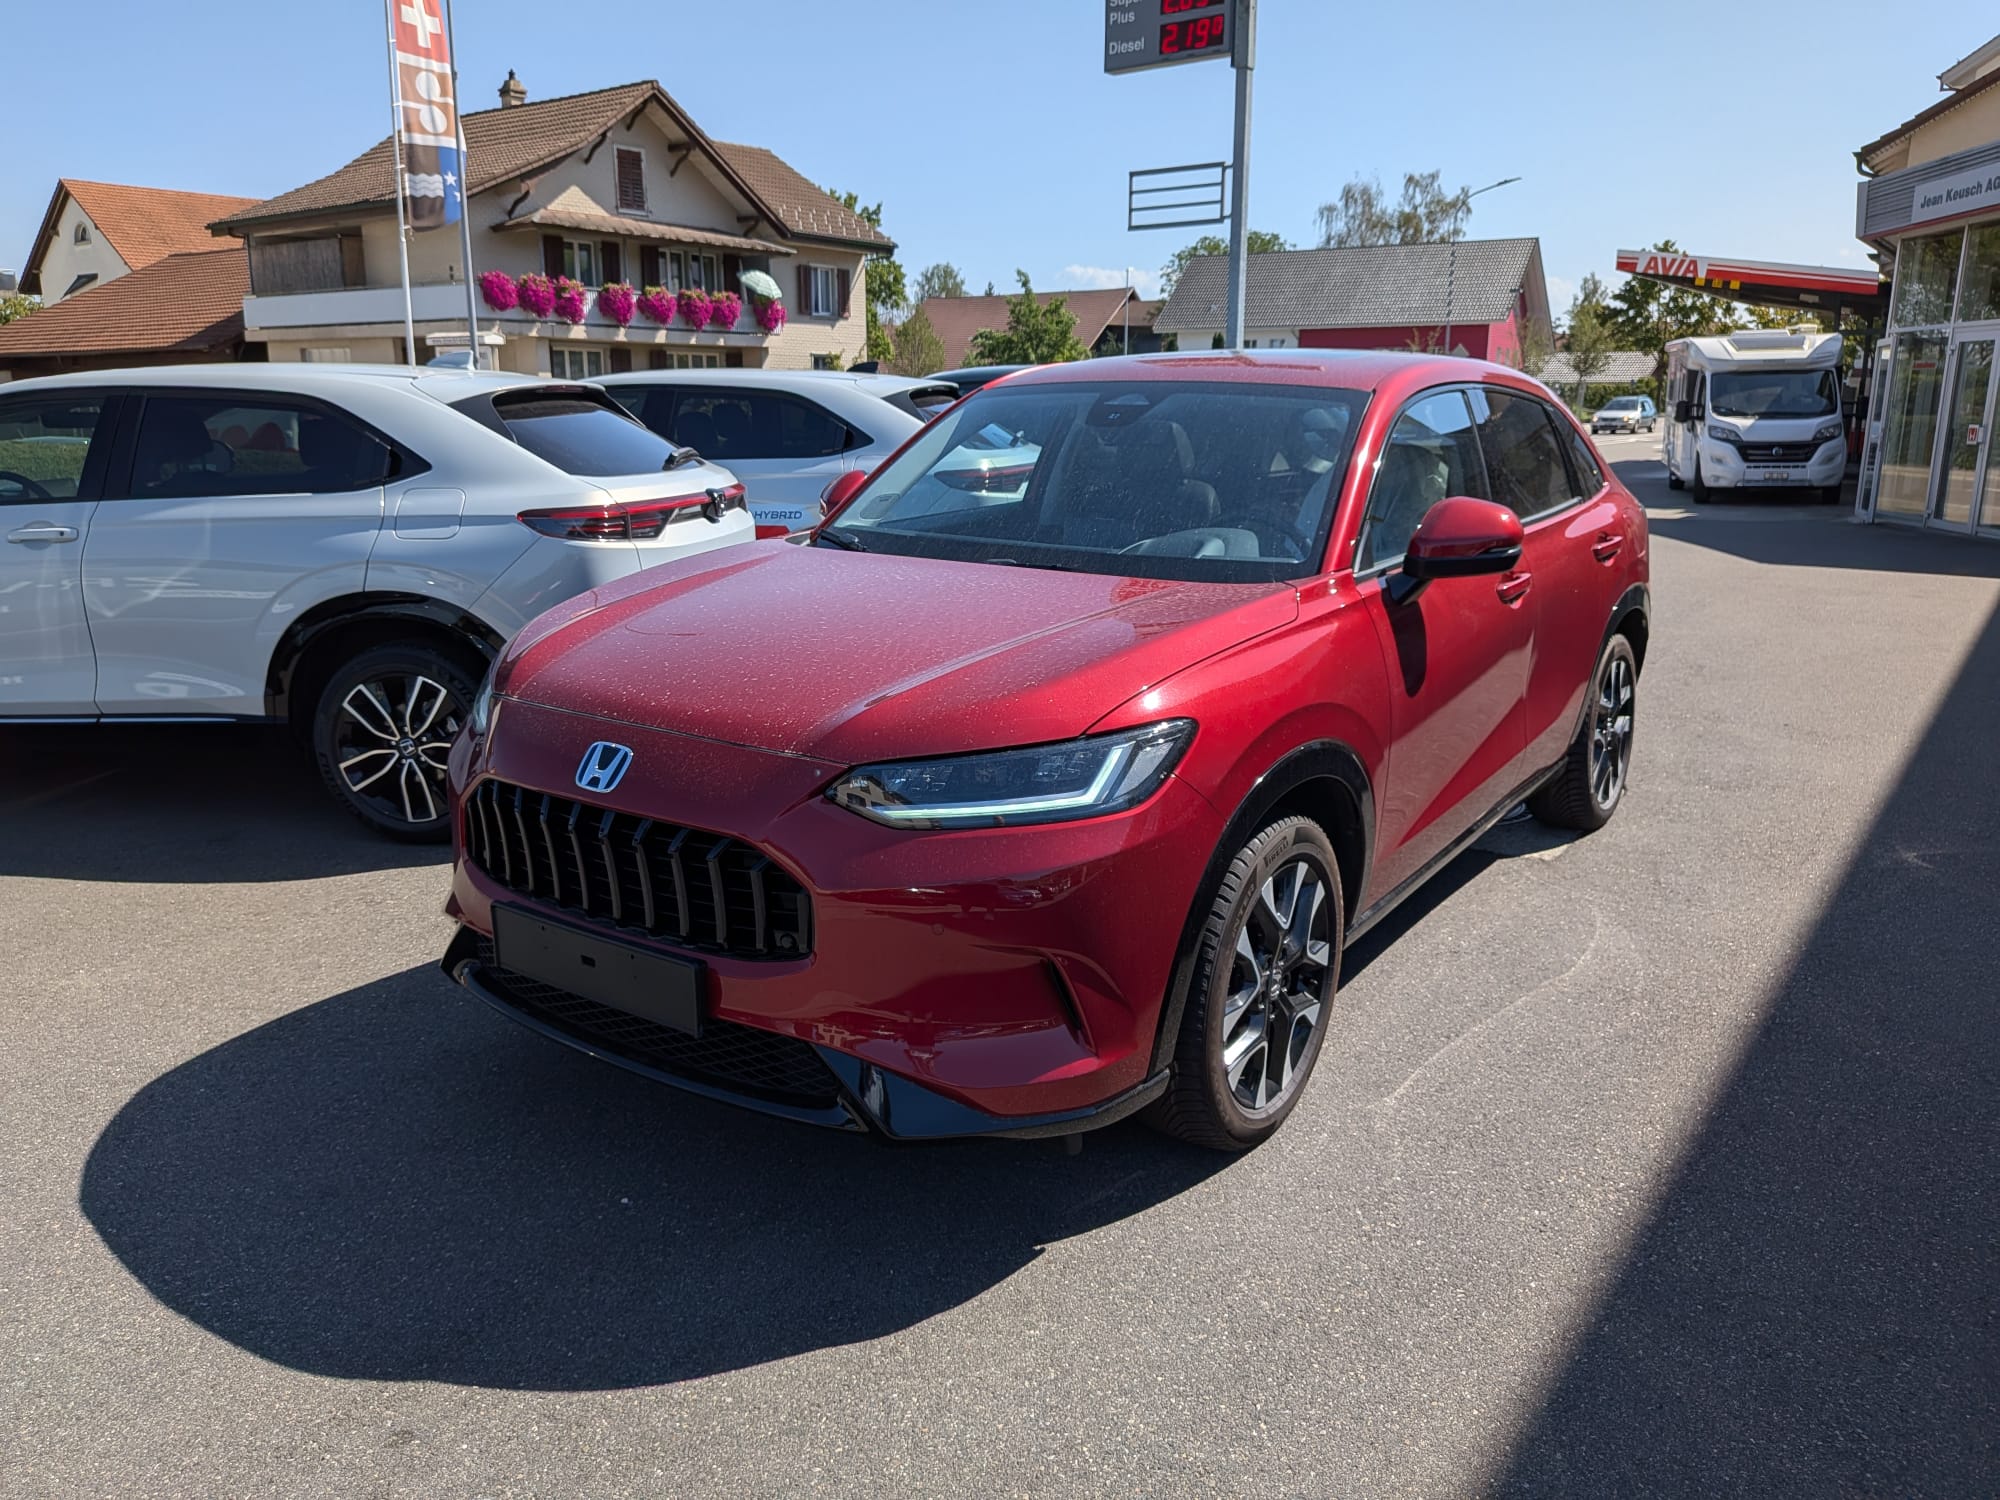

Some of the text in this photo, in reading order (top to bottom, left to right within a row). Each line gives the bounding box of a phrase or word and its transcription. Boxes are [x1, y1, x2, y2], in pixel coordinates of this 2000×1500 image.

[1110, 0, 1143, 8] Sup
[1110, 11, 1135, 25] Plus
[1109, 36, 1145, 55] Diesel
[1920, 176, 2000, 209] Jean Keusch AG
[1642, 253, 1699, 278] AVIA
[754, 510, 803, 520] HYBRID
